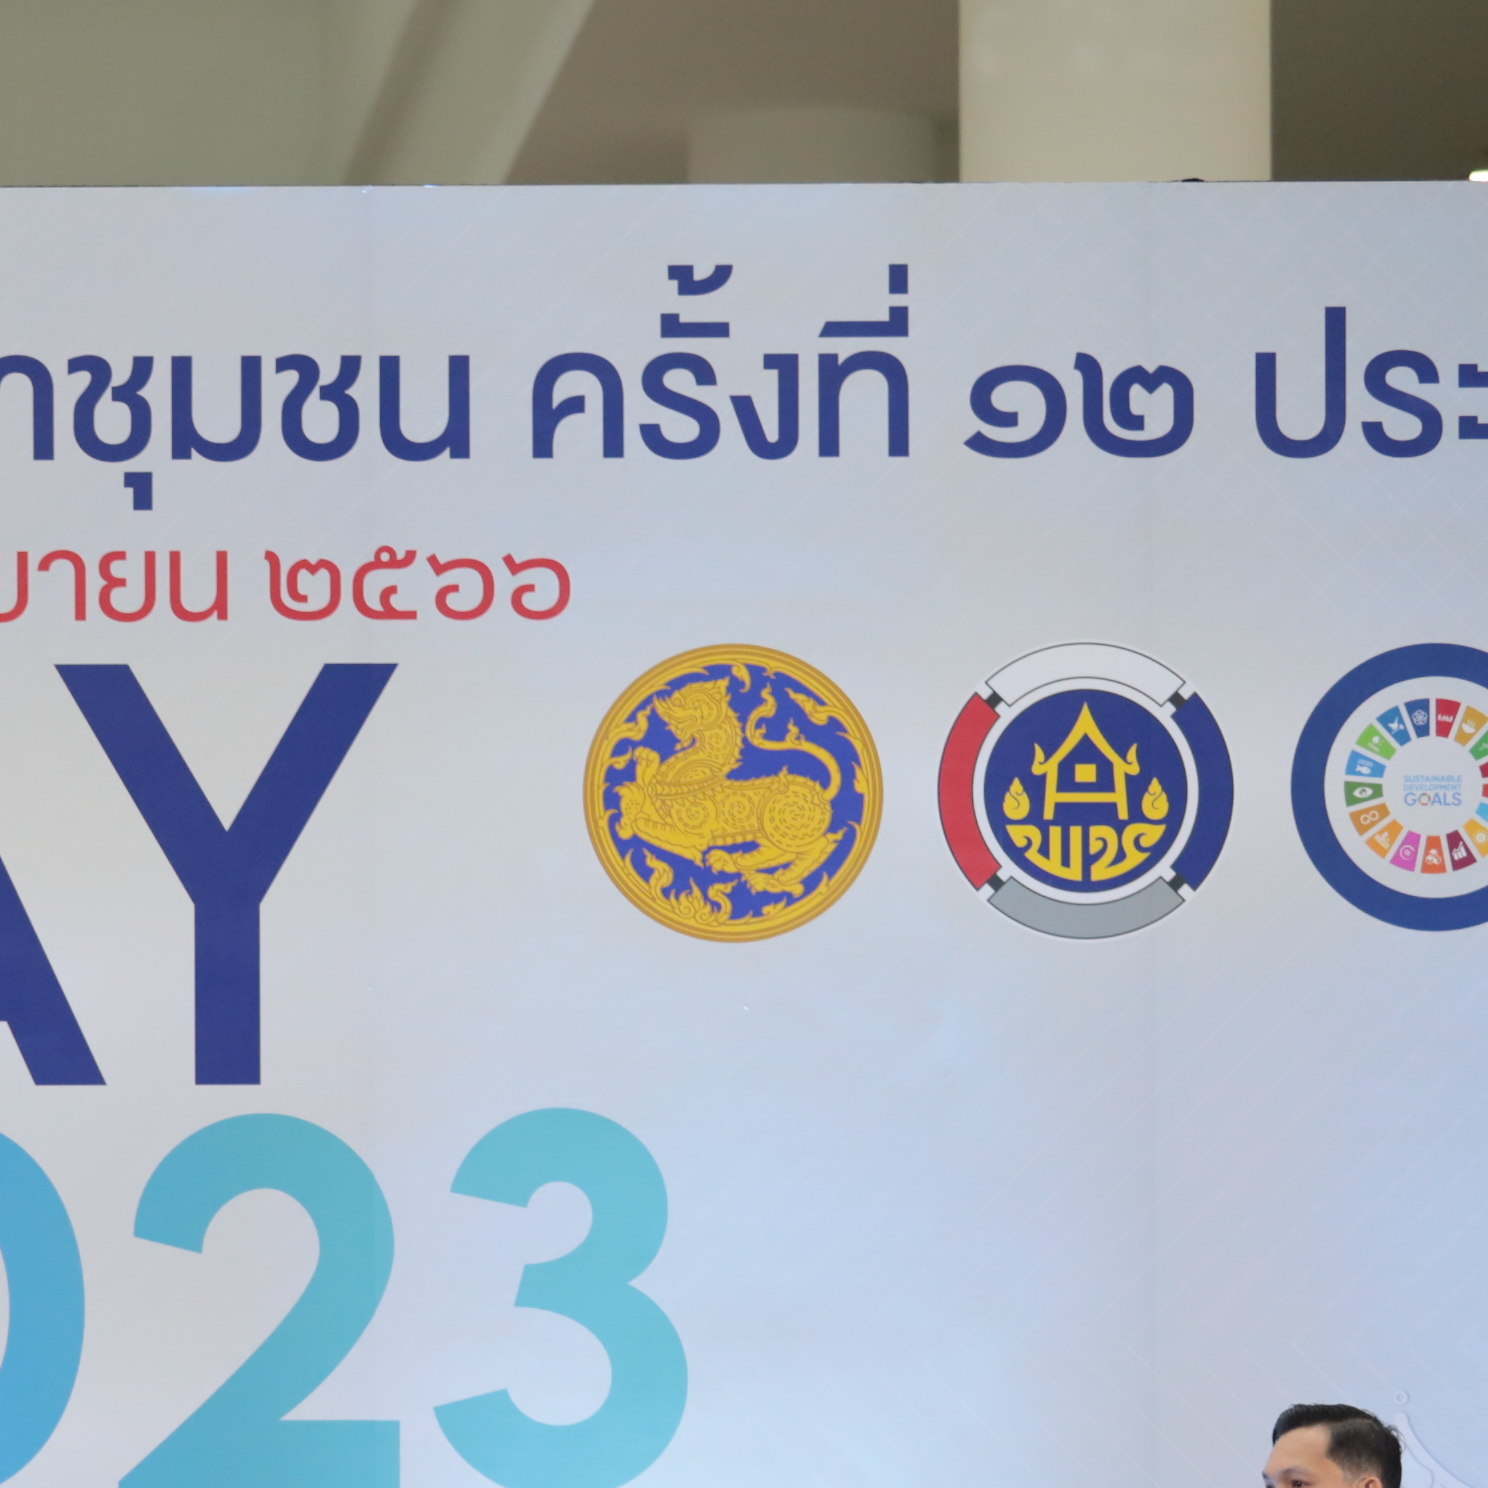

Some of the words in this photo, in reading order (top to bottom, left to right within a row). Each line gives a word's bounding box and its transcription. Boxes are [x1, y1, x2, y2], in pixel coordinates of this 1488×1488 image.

[533, 263, 910, 460] ครั้งที่
[963, 352, 1195, 459] ๑๒
[263, 545, 572, 622] ๒๕๖๖
[1403, 774, 1463, 783] SUSTAINABLE
[1403, 783, 1462, 791] DEVELOPMENT
[1403, 791, 1463, 807] GOALS
